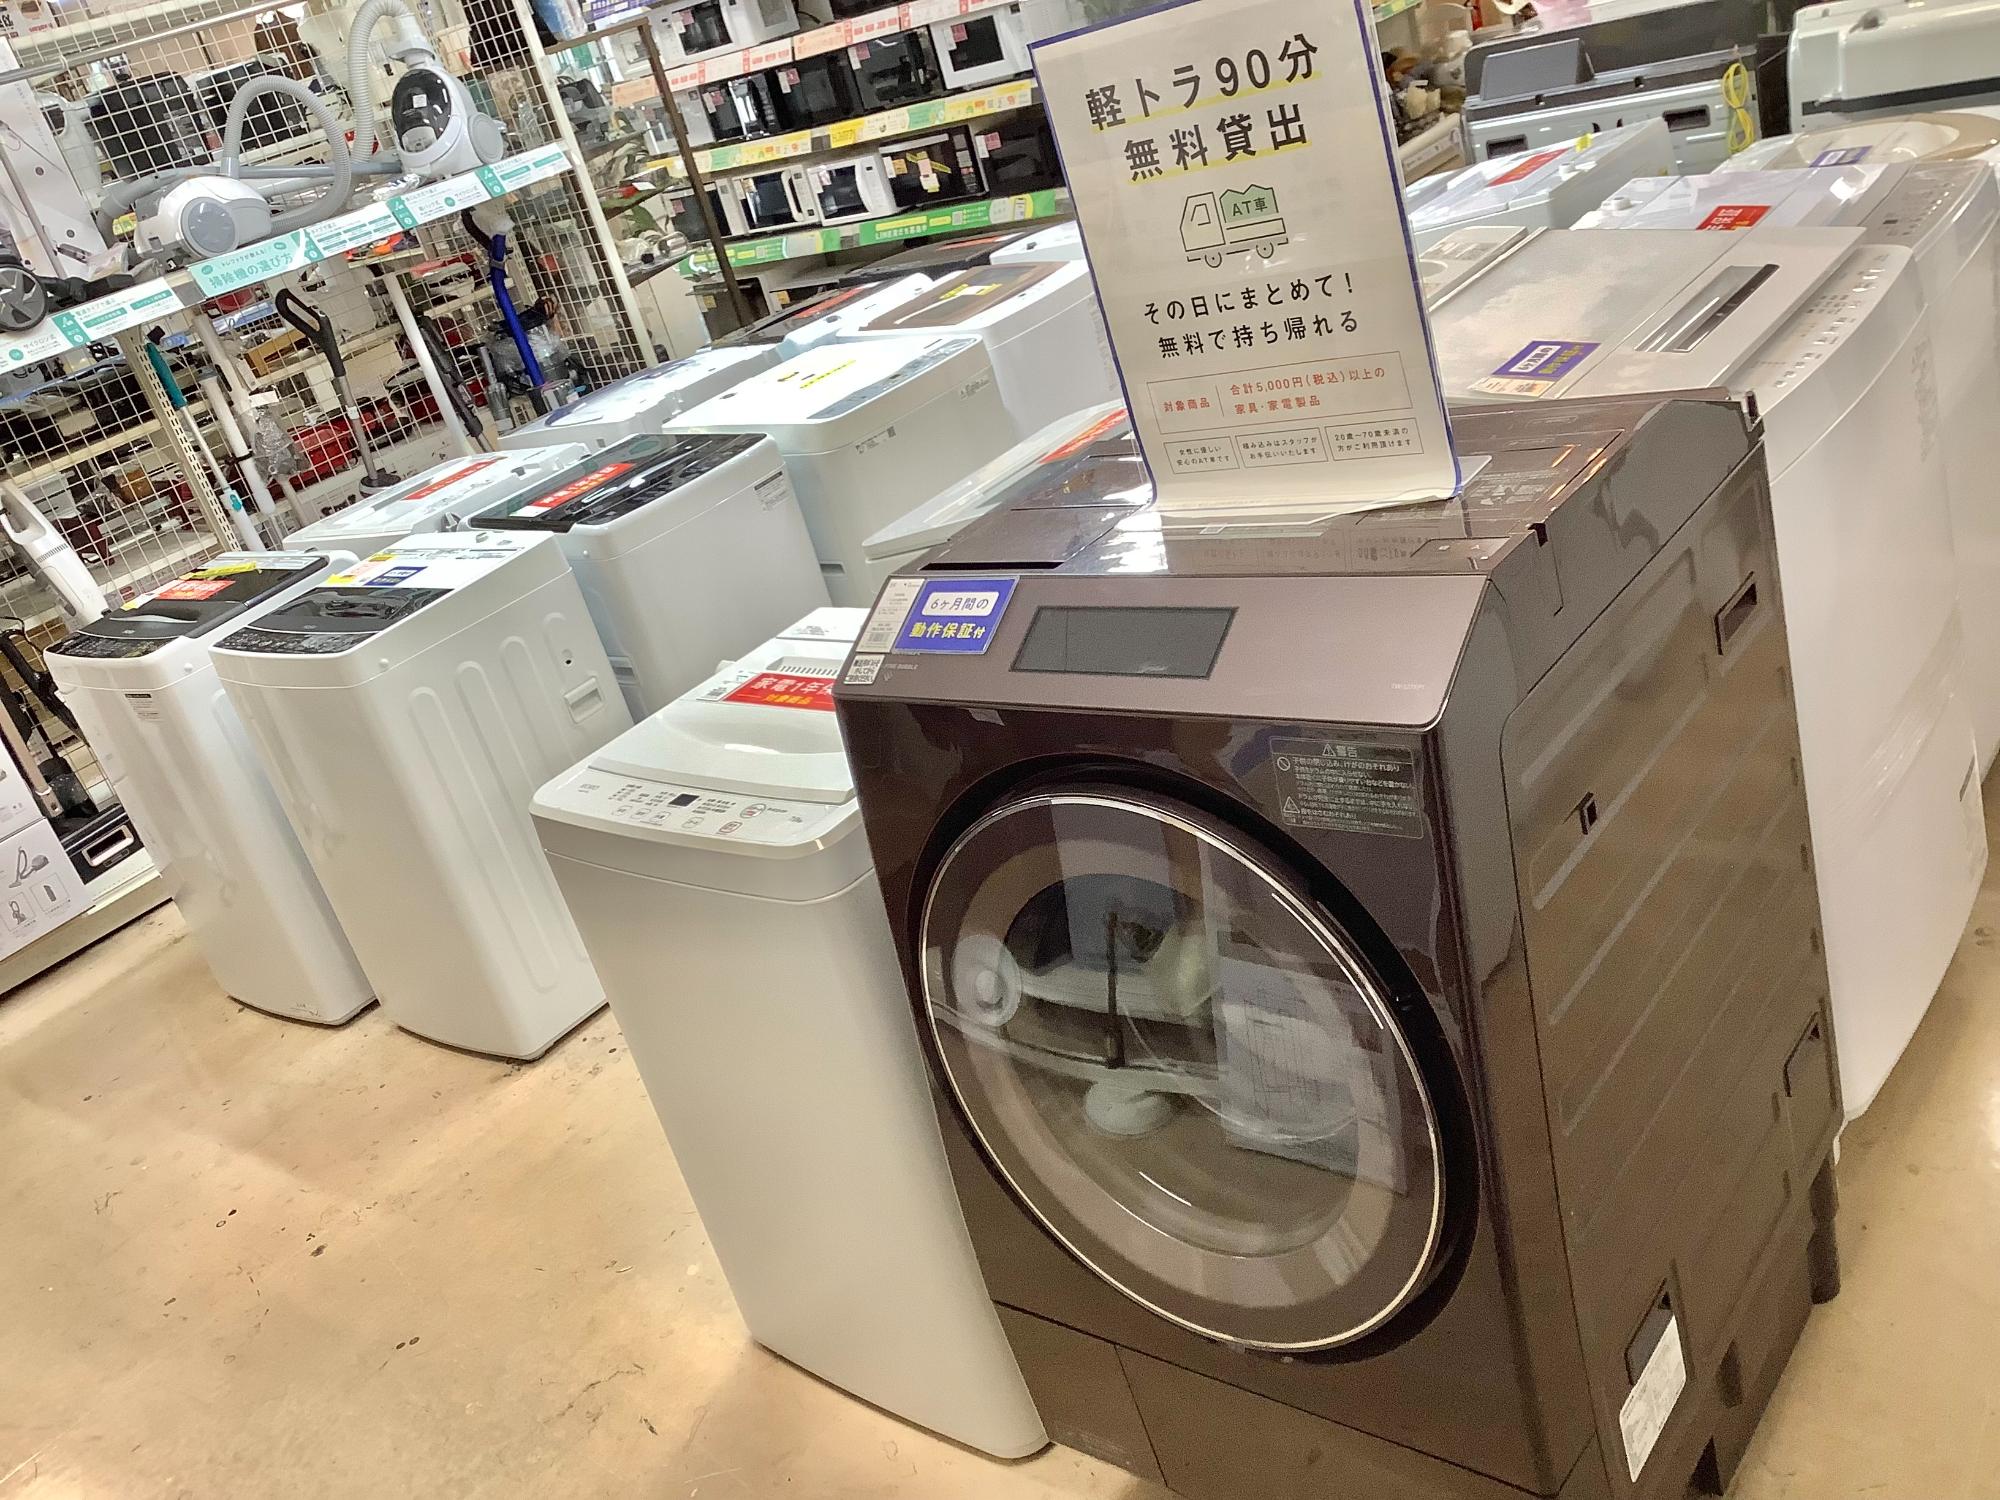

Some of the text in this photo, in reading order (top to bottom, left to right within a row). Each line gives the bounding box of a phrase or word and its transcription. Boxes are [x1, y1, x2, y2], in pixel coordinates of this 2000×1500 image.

[1086, 33, 1319, 130] 軽トラ90分
[1124, 103, 1307, 181] 無料貸出
[1231, 198, 1269, 218] AT車
[208, 253, 293, 288] 掃除機の選び方
[1144, 273, 1355, 325] その日にまとめて！
[1157, 310, 1359, 358] 無料で持ち帰れる
[1163, 397, 1211, 413] 対象商品
[930, 597, 989, 611] 6ヶ月間の
[909, 622, 985, 639] 動作保証付
